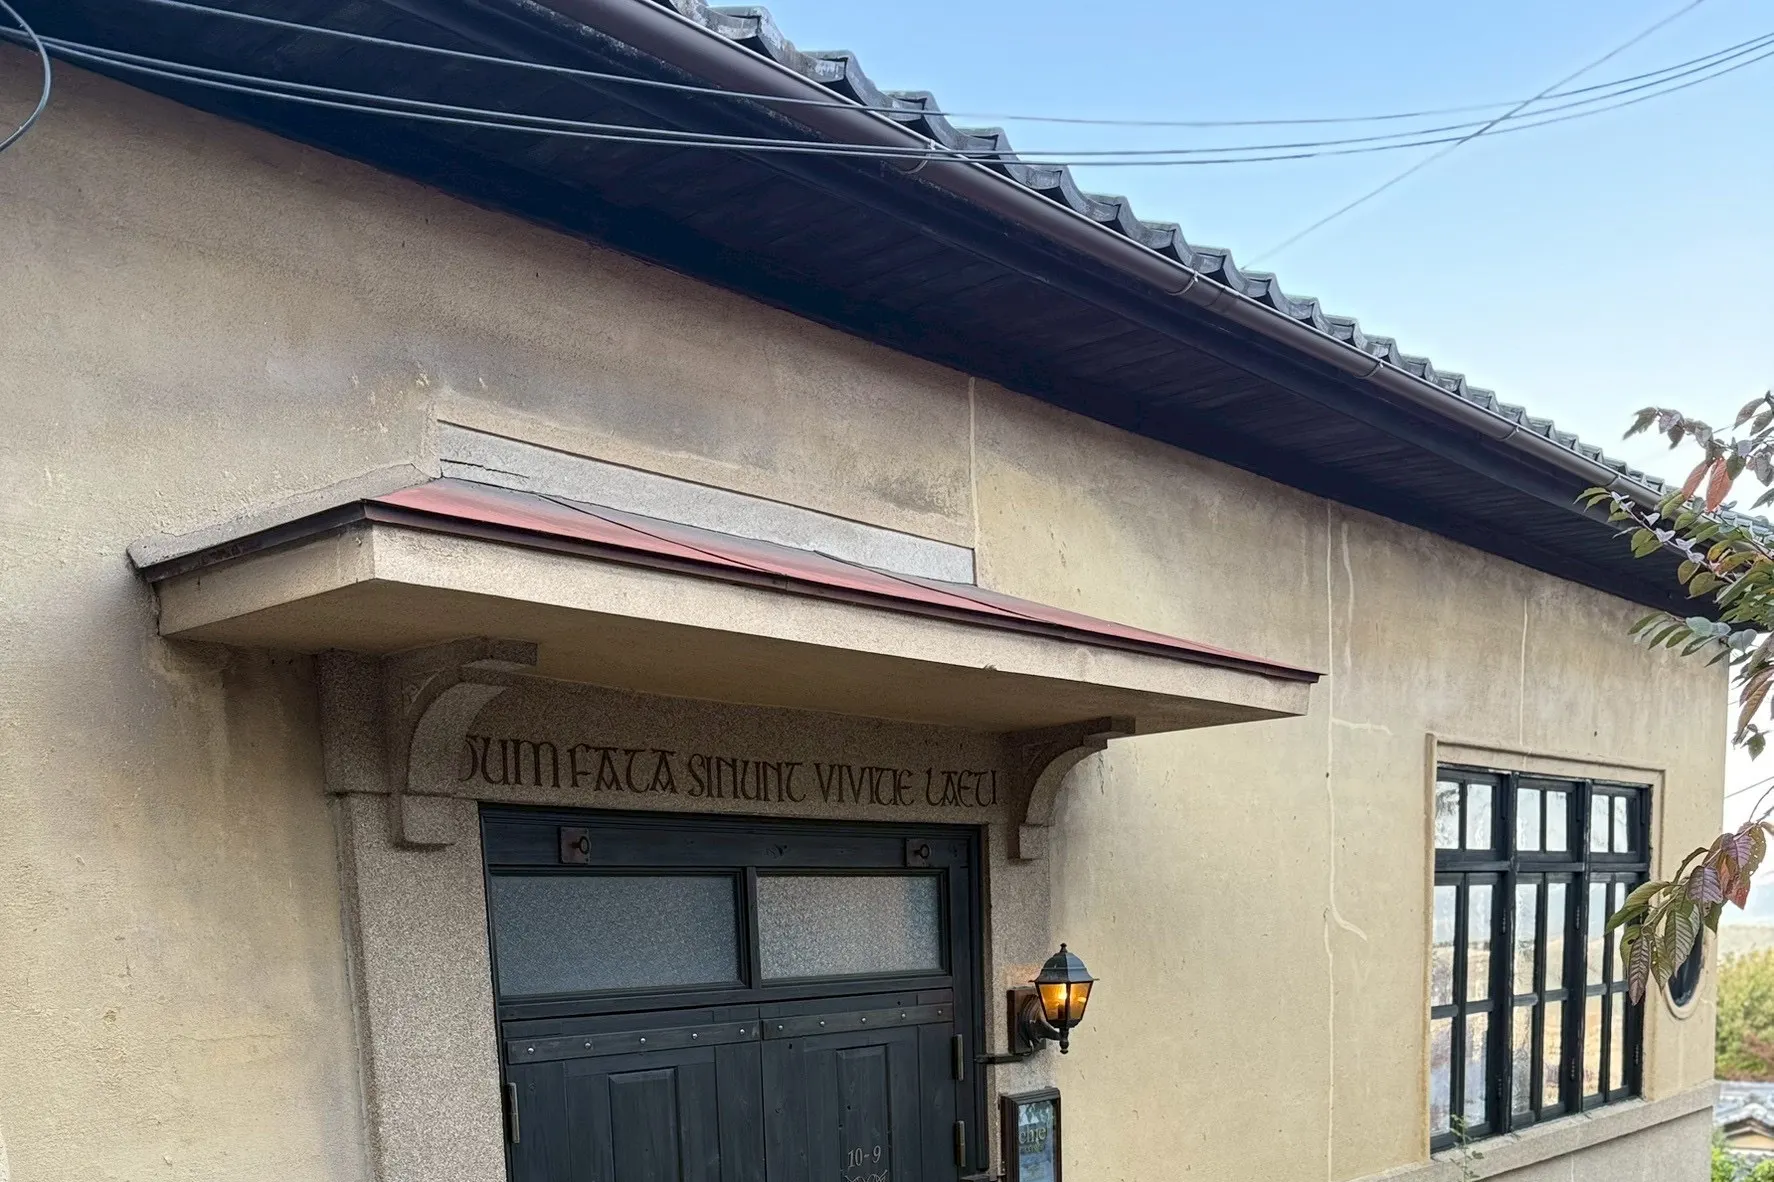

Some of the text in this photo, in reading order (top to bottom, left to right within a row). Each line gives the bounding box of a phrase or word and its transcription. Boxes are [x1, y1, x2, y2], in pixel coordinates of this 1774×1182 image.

[567, 743, 679, 795] FATA
[688, 753, 806, 803] SINUNT
[847, 1145, 882, 1168] 10-9
